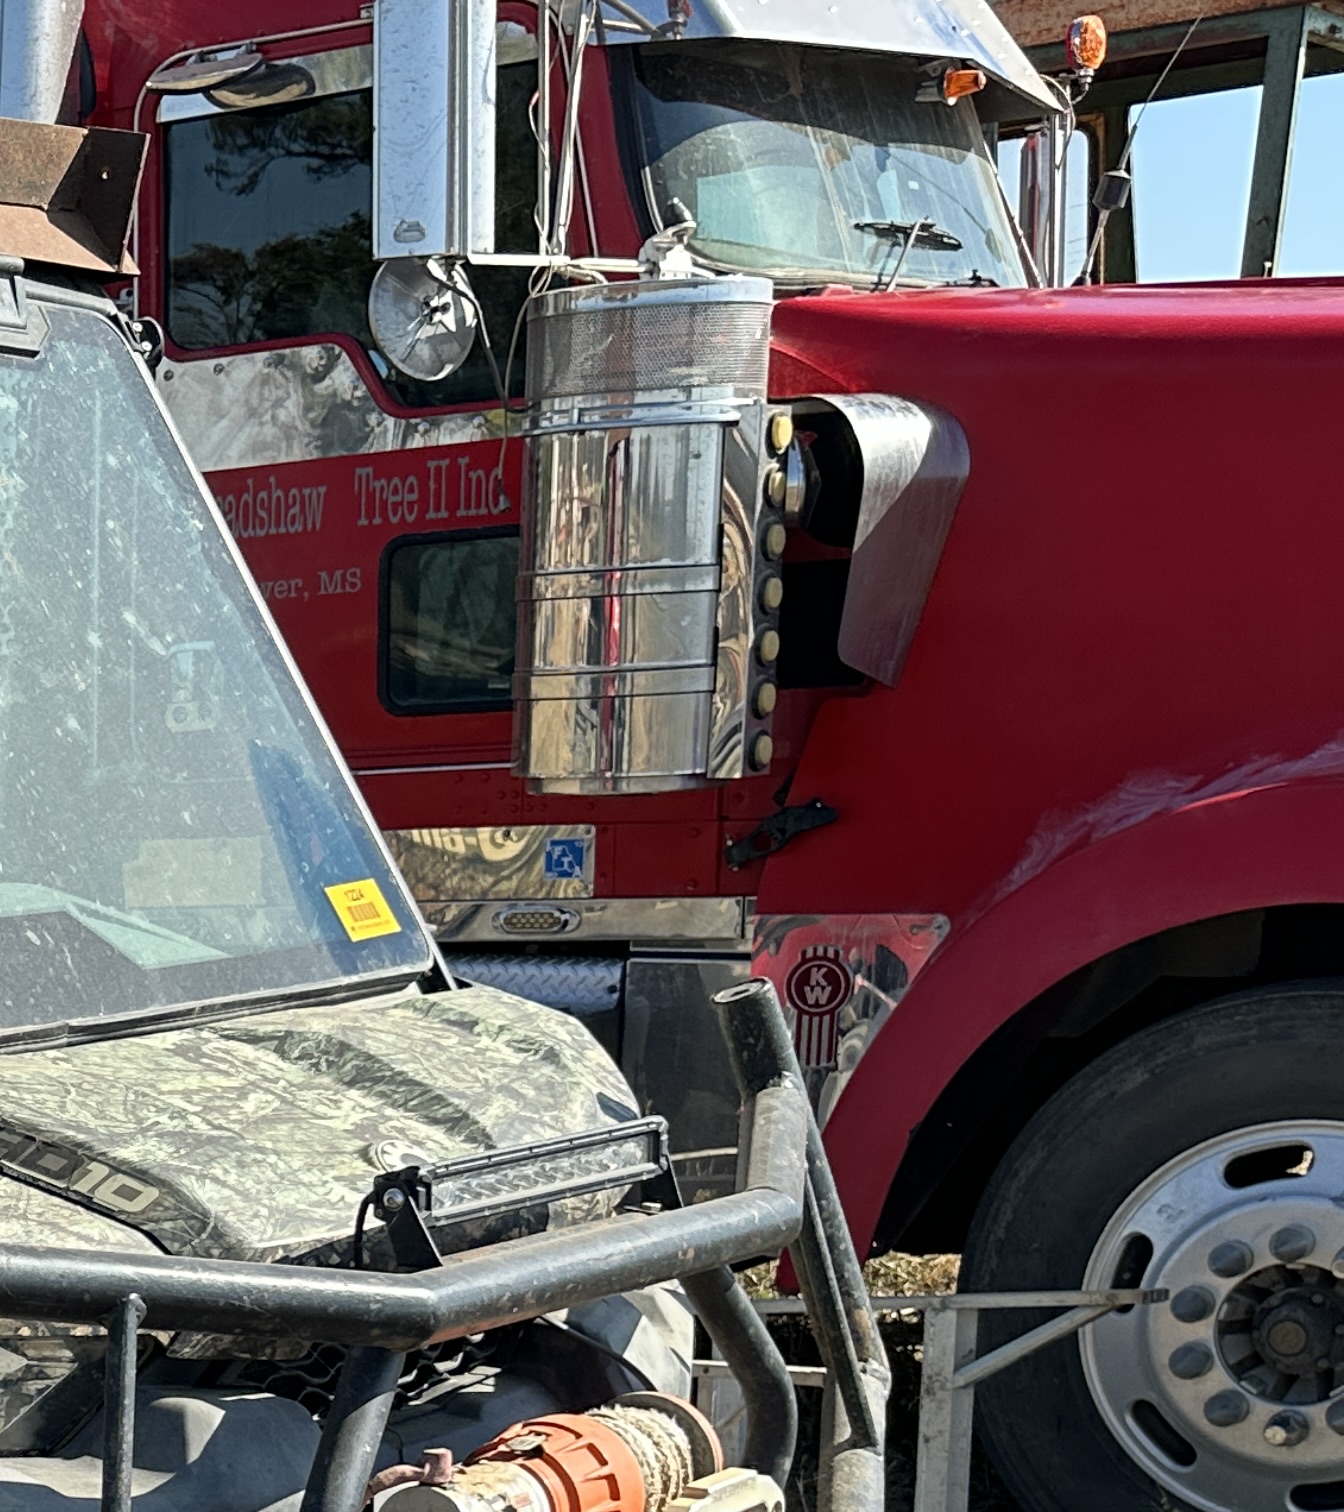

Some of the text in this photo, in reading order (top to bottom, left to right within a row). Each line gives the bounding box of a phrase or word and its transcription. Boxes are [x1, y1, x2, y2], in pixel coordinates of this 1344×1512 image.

[216, 476, 327, 539] adshaw
[354, 466, 419, 526] Tree
[425, 458, 450, 520] II
[317, 567, 362, 596] MS
